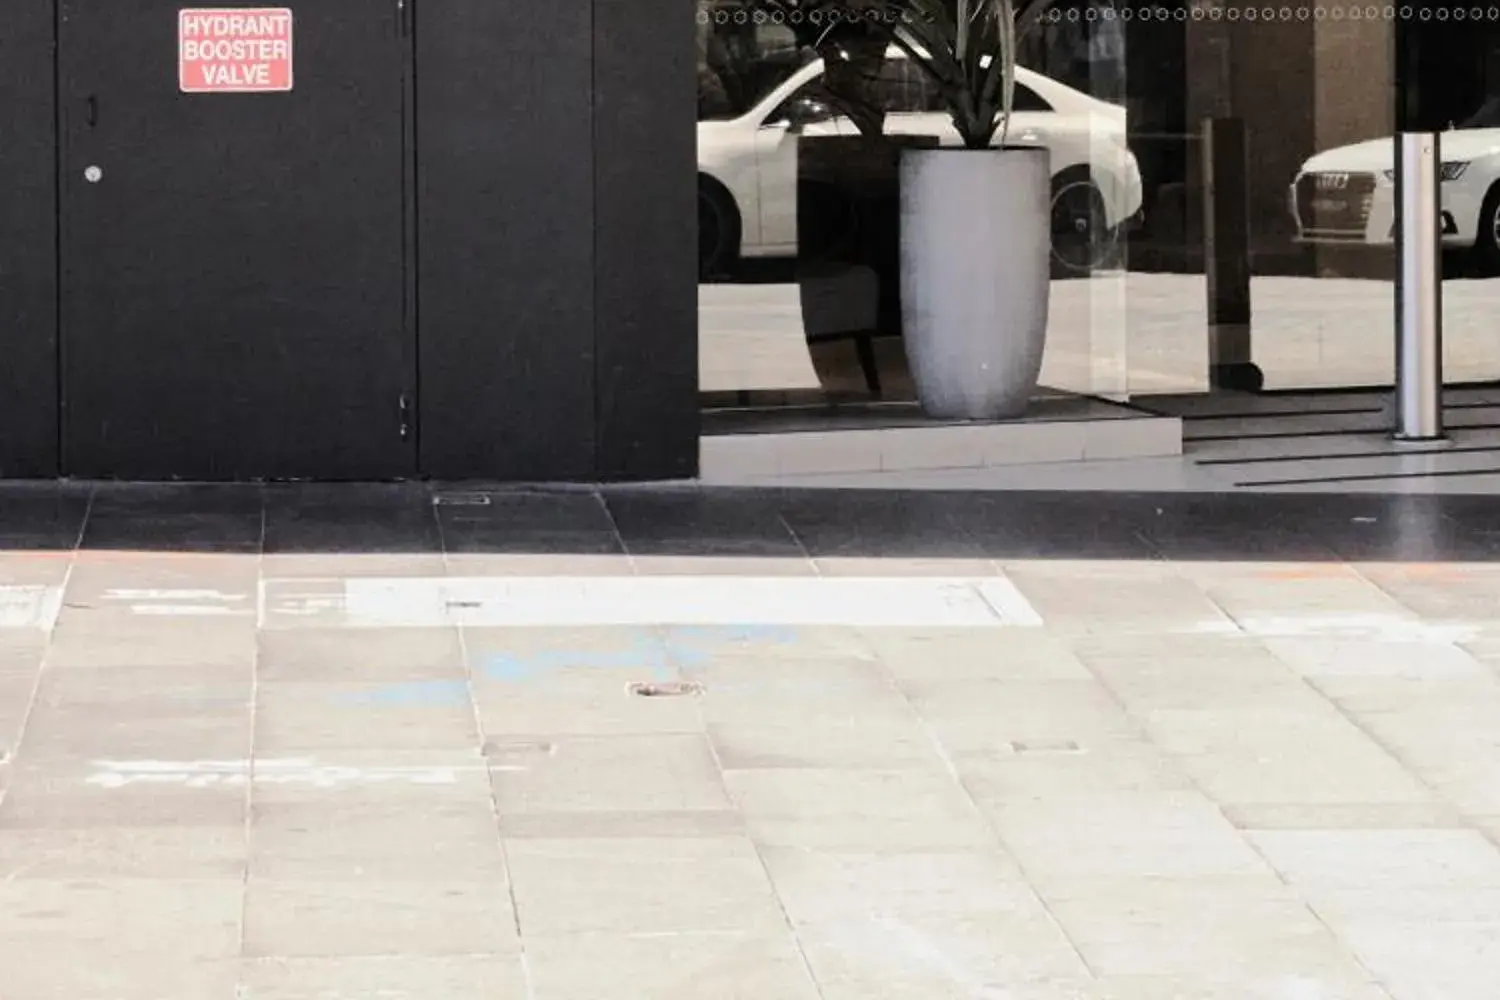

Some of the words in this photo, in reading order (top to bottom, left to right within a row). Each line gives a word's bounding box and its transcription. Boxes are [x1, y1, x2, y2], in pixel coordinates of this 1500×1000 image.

[183, 15, 289, 36] HYDRANT
[183, 39, 288, 61] BOOSTER
[202, 63, 270, 85] VALVE
